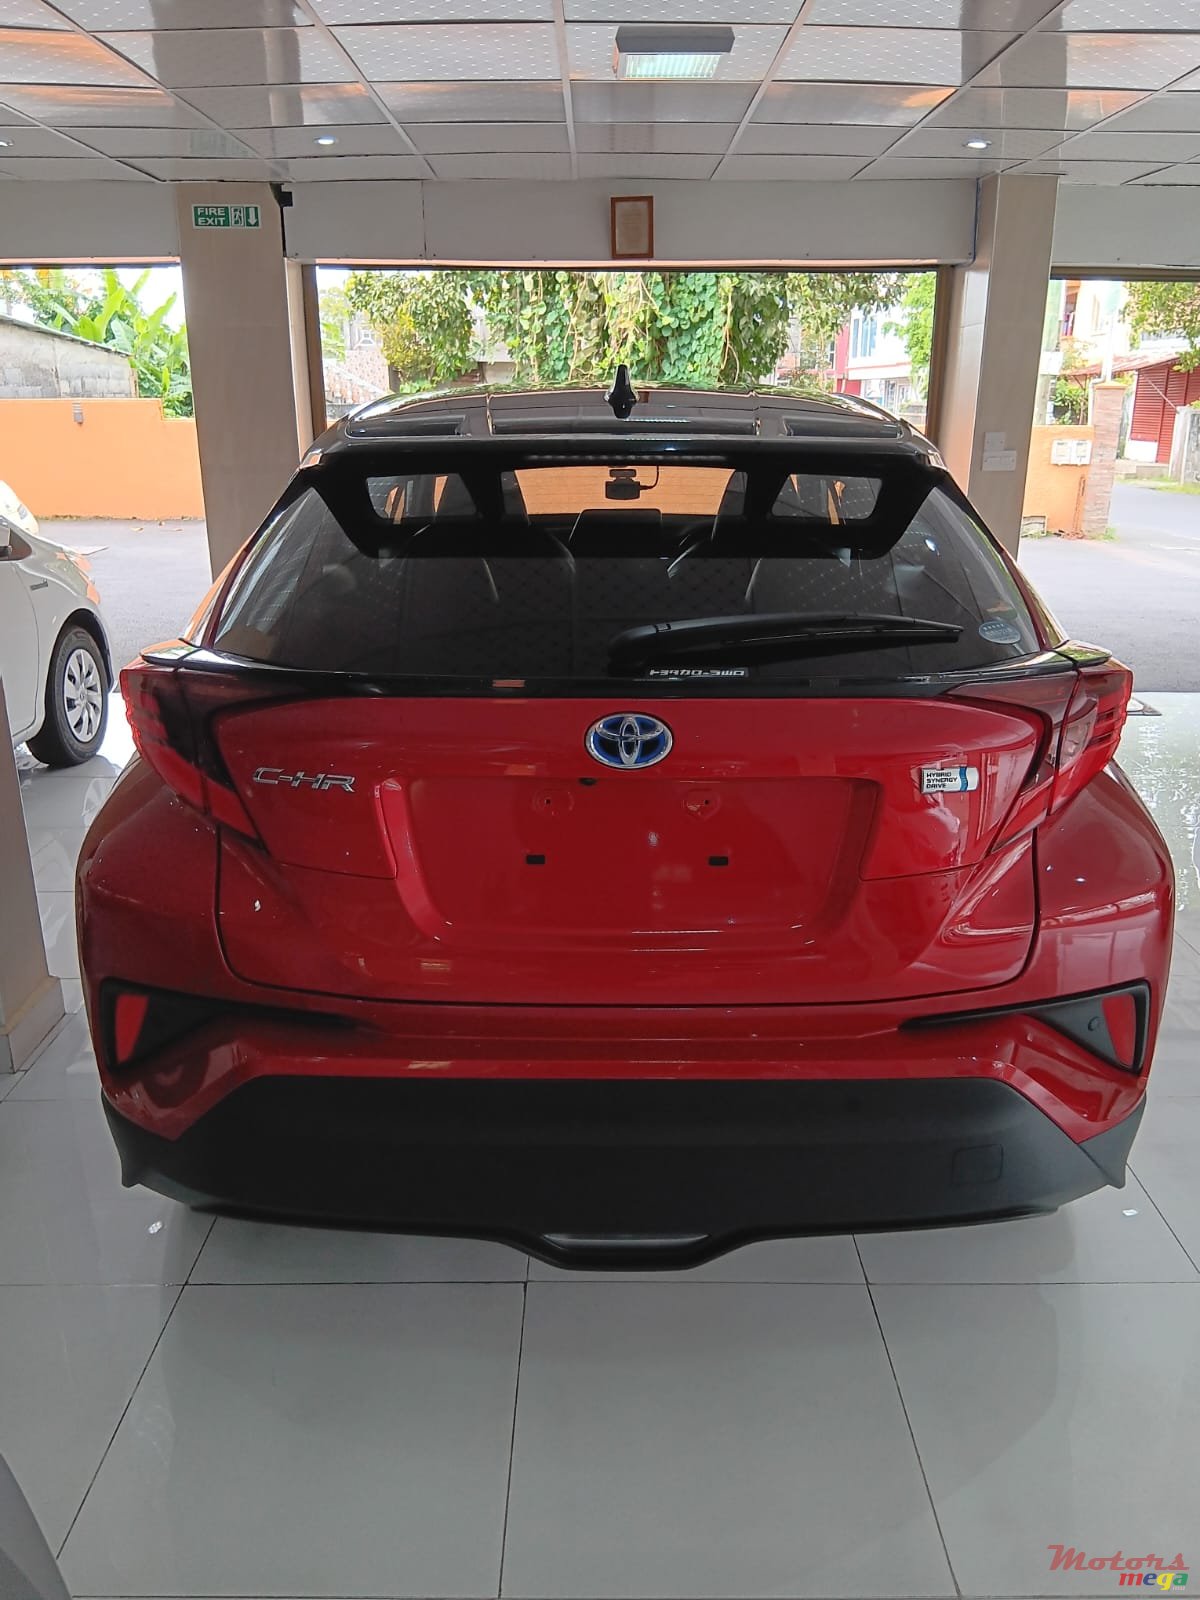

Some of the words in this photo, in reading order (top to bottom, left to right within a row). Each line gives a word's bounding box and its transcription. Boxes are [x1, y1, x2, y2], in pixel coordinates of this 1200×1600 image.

[198, 207, 225, 216] FIRE
[198, 218, 225, 226] EXIT
[253, 767, 355, 793] C-HR
